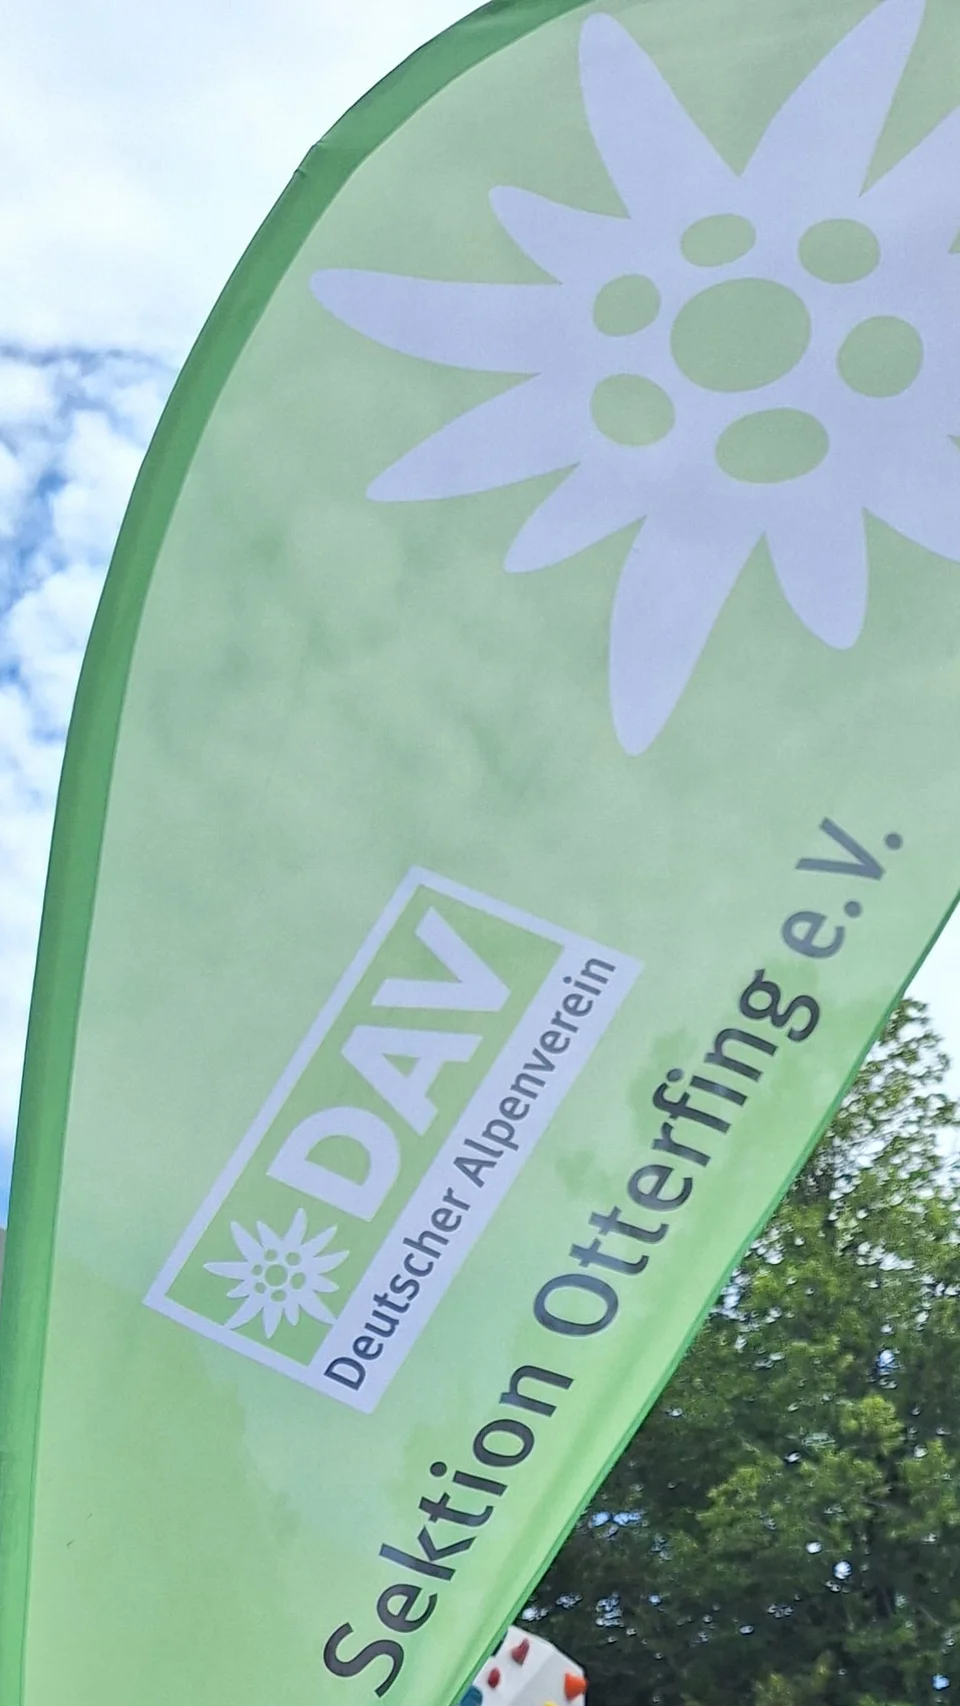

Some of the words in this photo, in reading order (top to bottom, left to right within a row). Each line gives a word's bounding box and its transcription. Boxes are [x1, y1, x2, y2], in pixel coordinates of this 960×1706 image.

[266, 907, 511, 1222] DAV
[323, 1361, 573, 1698] Sektion
[534, 968, 820, 1339] Otterfing
[780, 817, 904, 960] e.V.
[324, 1187, 471, 1391] Deutscher
[454, 957, 616, 1188] Alpenverein
